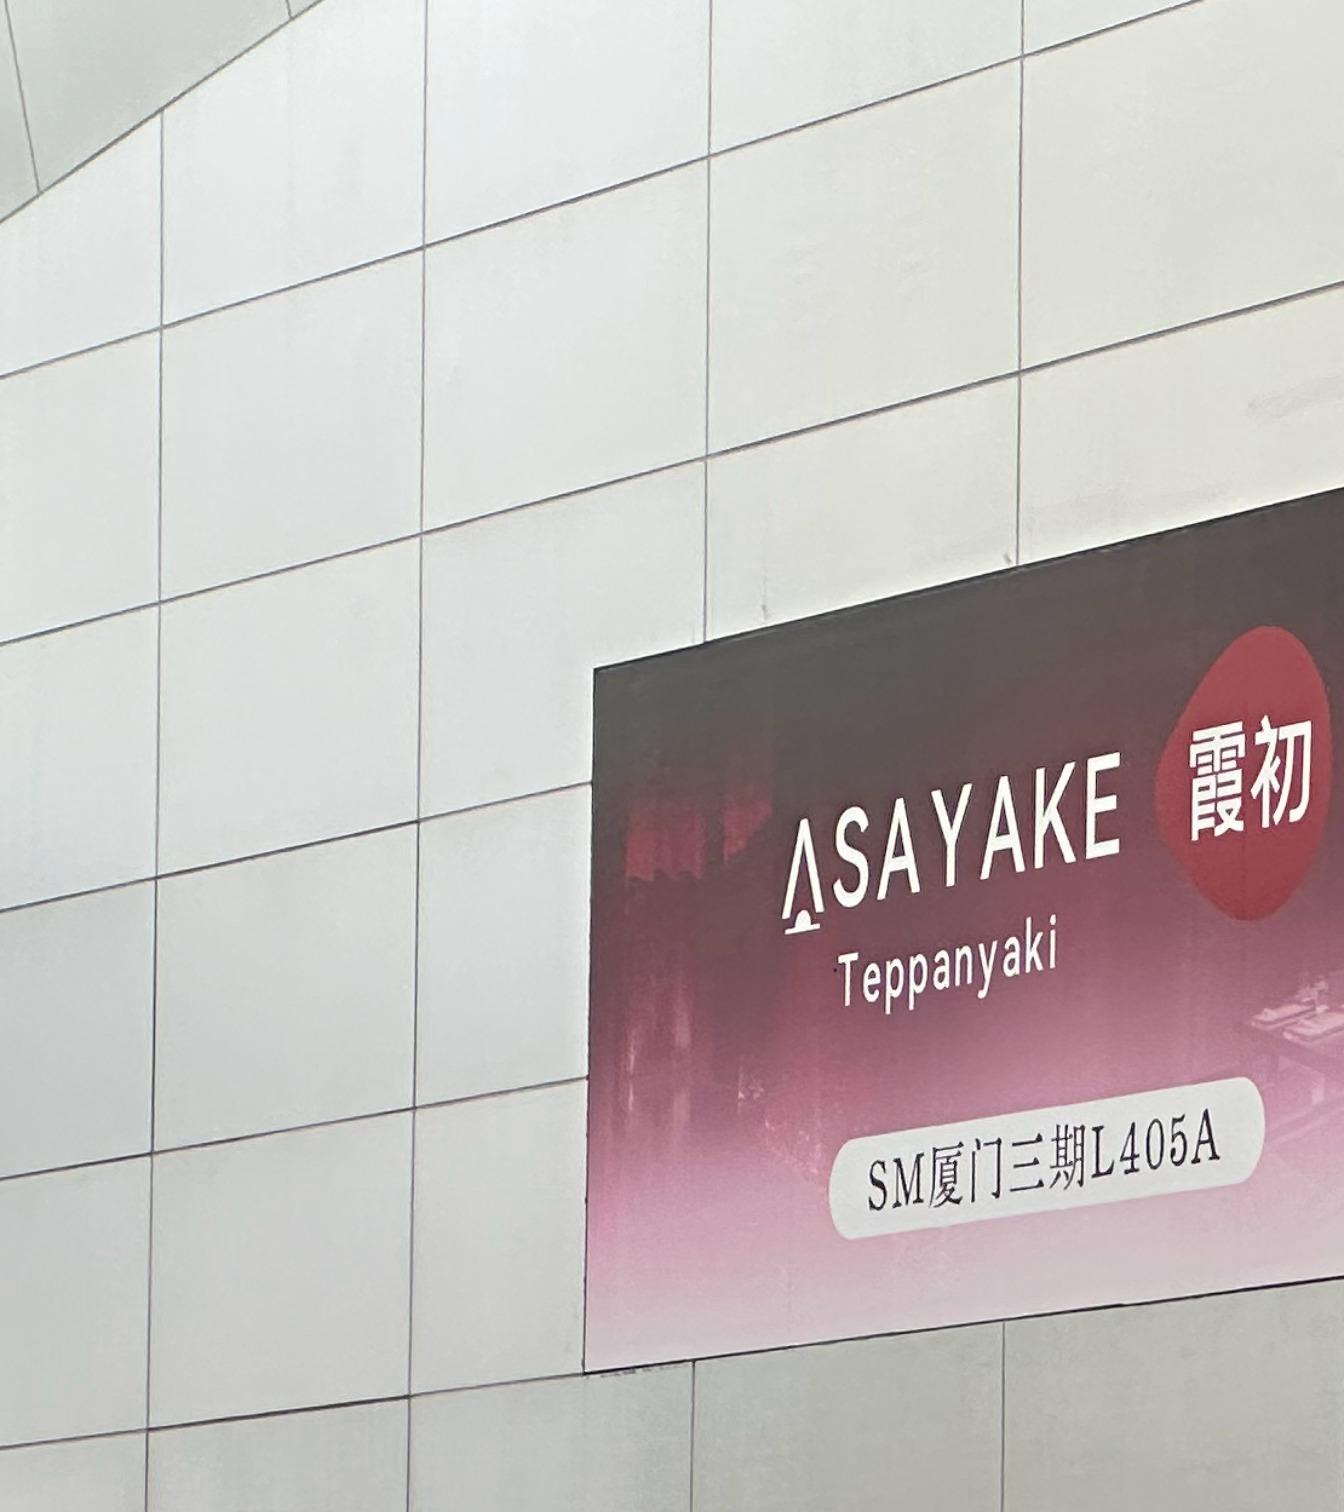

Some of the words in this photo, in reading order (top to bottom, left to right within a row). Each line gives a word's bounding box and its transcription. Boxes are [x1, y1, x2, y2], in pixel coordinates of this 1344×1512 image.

[1188, 715, 1313, 842] 霞初
[781, 751, 1122, 932] ASAYAKE
[838, 914, 1058, 1014] Teppanyaki
[866, 1108, 1222, 1213] SM厦门三期L405A
